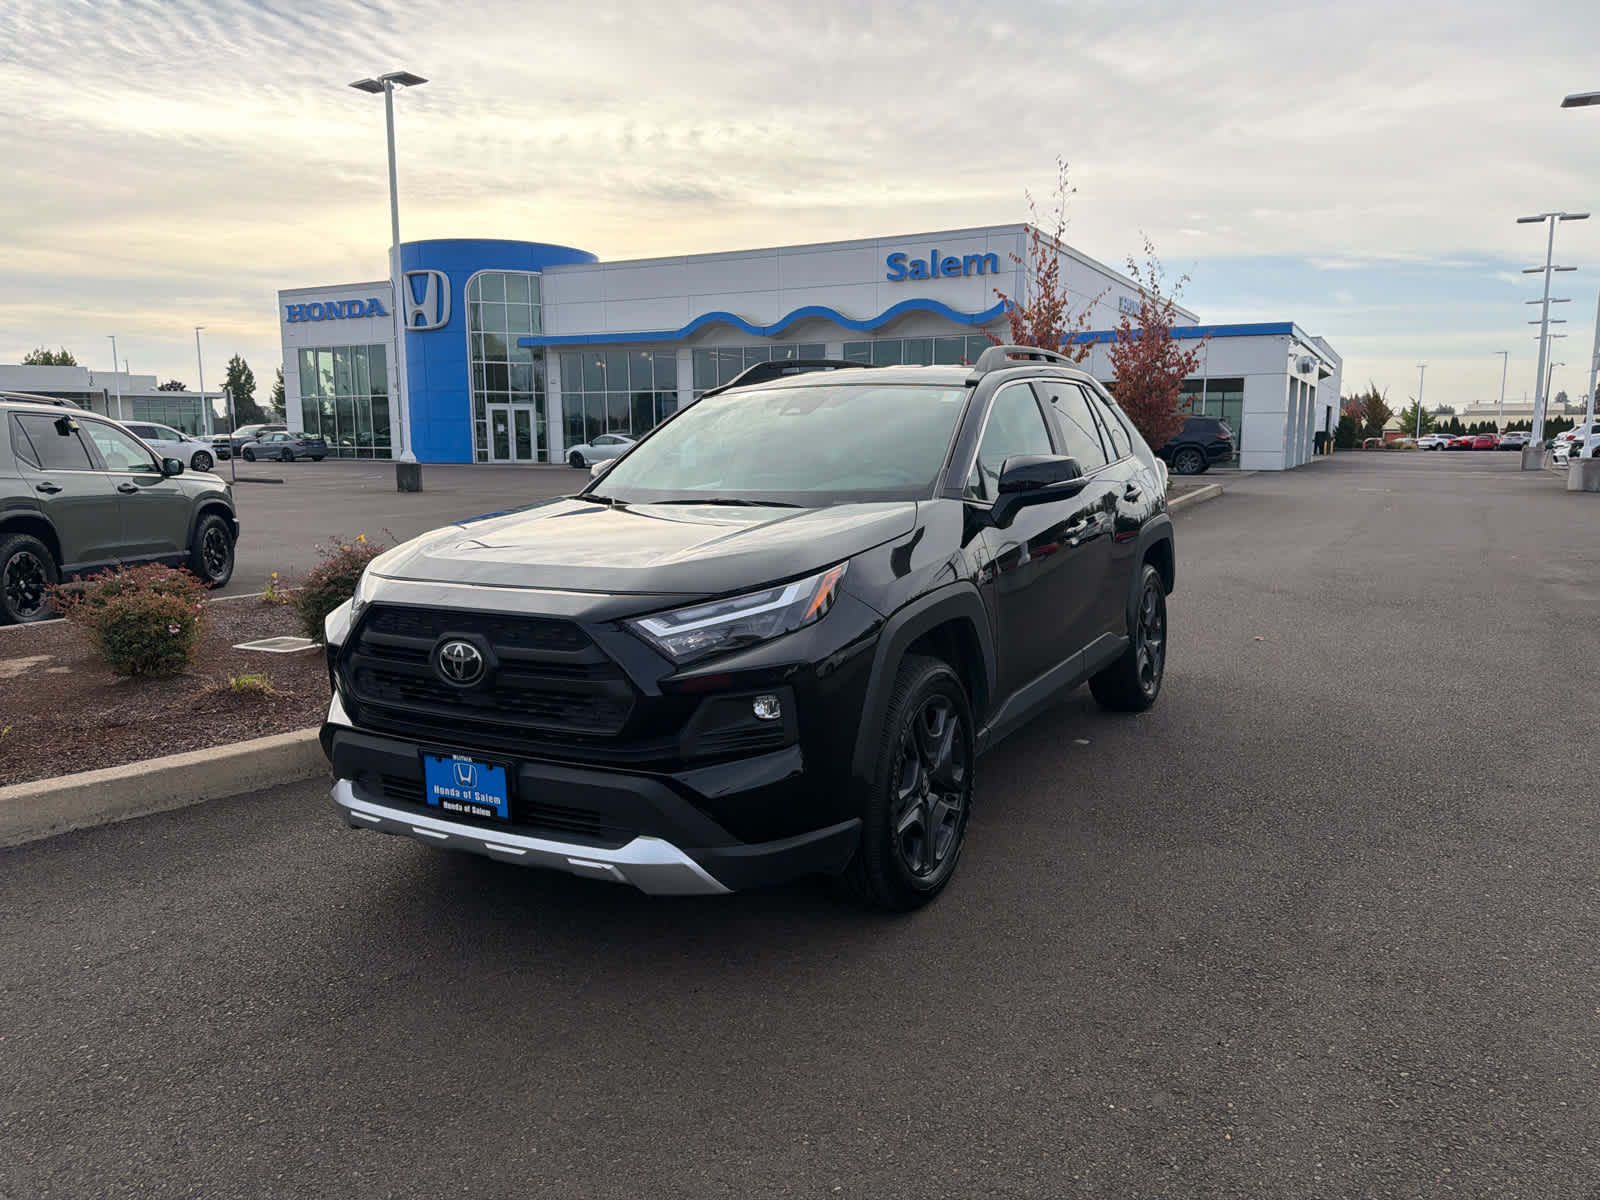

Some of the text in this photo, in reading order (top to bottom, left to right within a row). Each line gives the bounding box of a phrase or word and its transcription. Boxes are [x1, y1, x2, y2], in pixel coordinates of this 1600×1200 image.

[886, 248, 999, 281] Salem
[285, 298, 391, 323] HONDA
[433, 784, 501, 805] Honda of Salem
[443, 801, 491, 817] Honda of Salem
